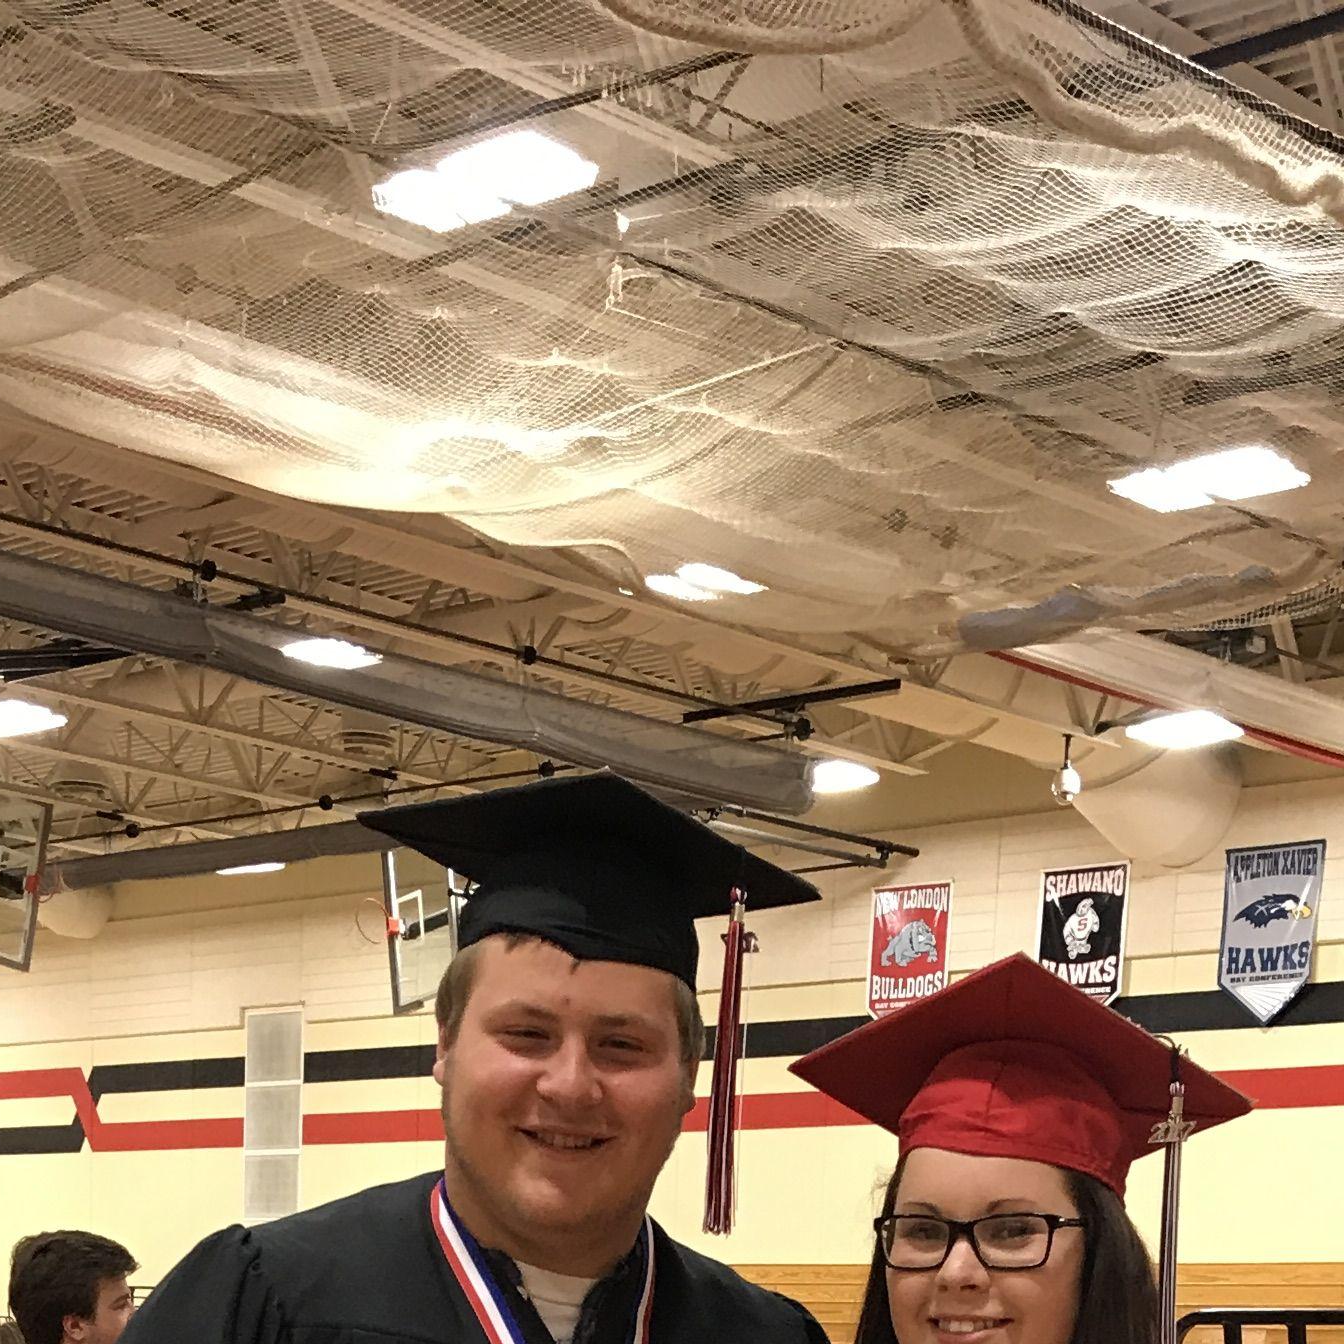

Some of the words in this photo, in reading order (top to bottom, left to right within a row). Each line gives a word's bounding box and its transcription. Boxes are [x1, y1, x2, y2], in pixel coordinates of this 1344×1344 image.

[1233, 851, 1280, 884] APPLETON
[1281, 847, 1318, 876] XAVIER
[903, 887, 948, 913] LONDON
[1046, 870, 1125, 902] SHAWANO
[1227, 940, 1311, 975] HAWKS
[872, 971, 943, 1000] BULLDOGS
